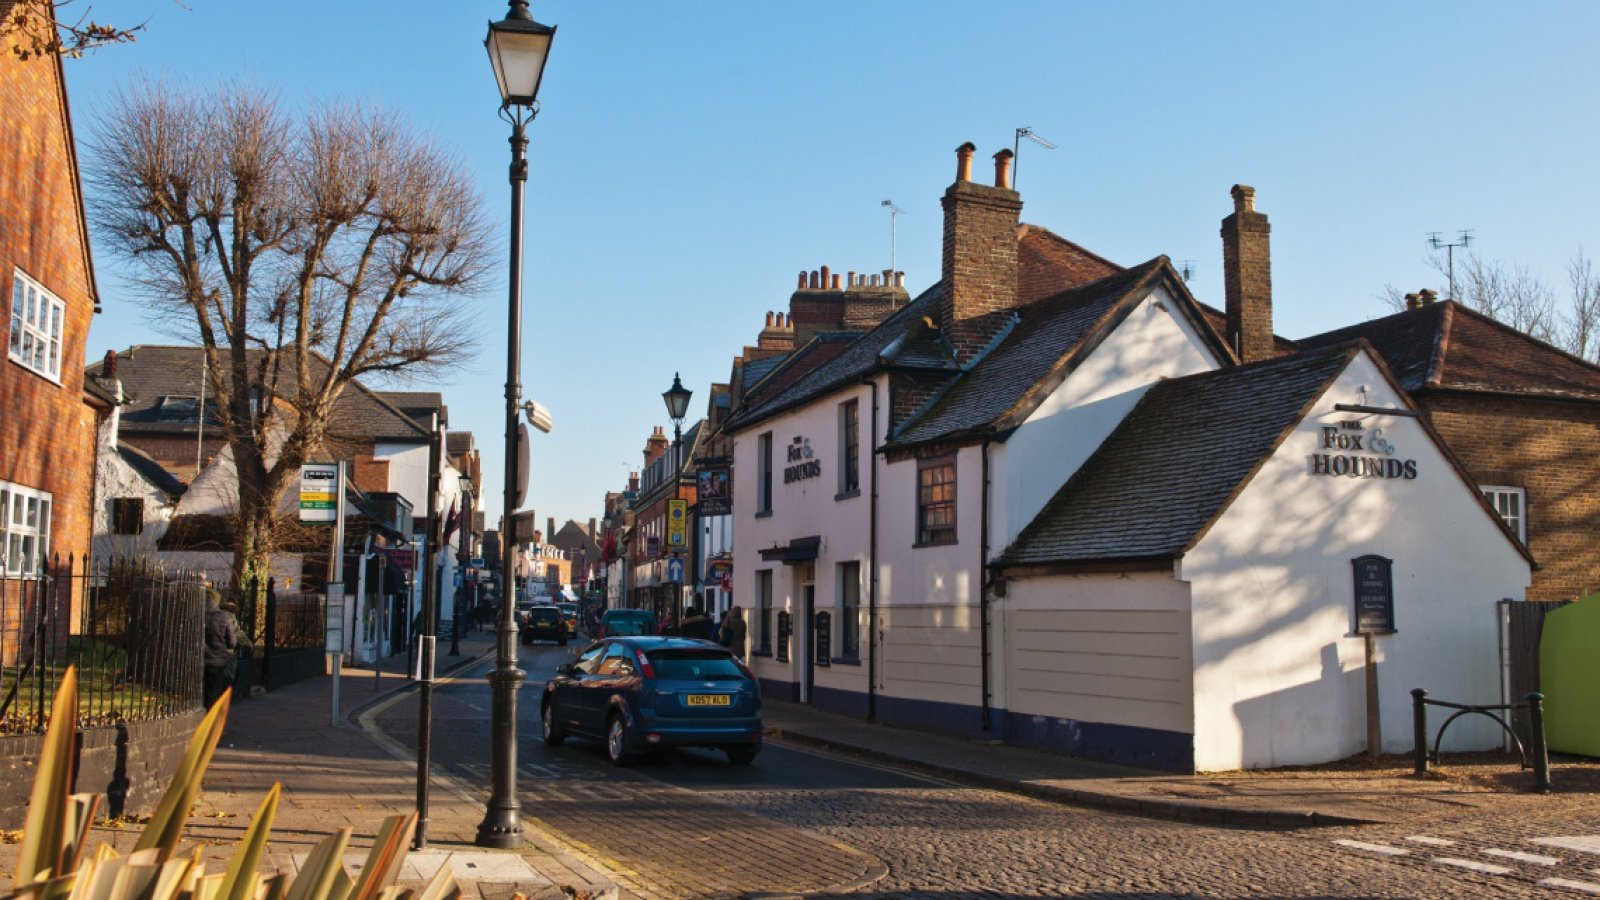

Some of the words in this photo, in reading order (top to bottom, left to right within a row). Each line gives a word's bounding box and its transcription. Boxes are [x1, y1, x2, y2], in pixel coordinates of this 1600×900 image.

[1341, 420, 1362, 431] THE
[1369, 428, 1395, 455] &
[784, 459, 821, 484] HOUNDS
[1312, 453, 1417, 480] HOUNDS
